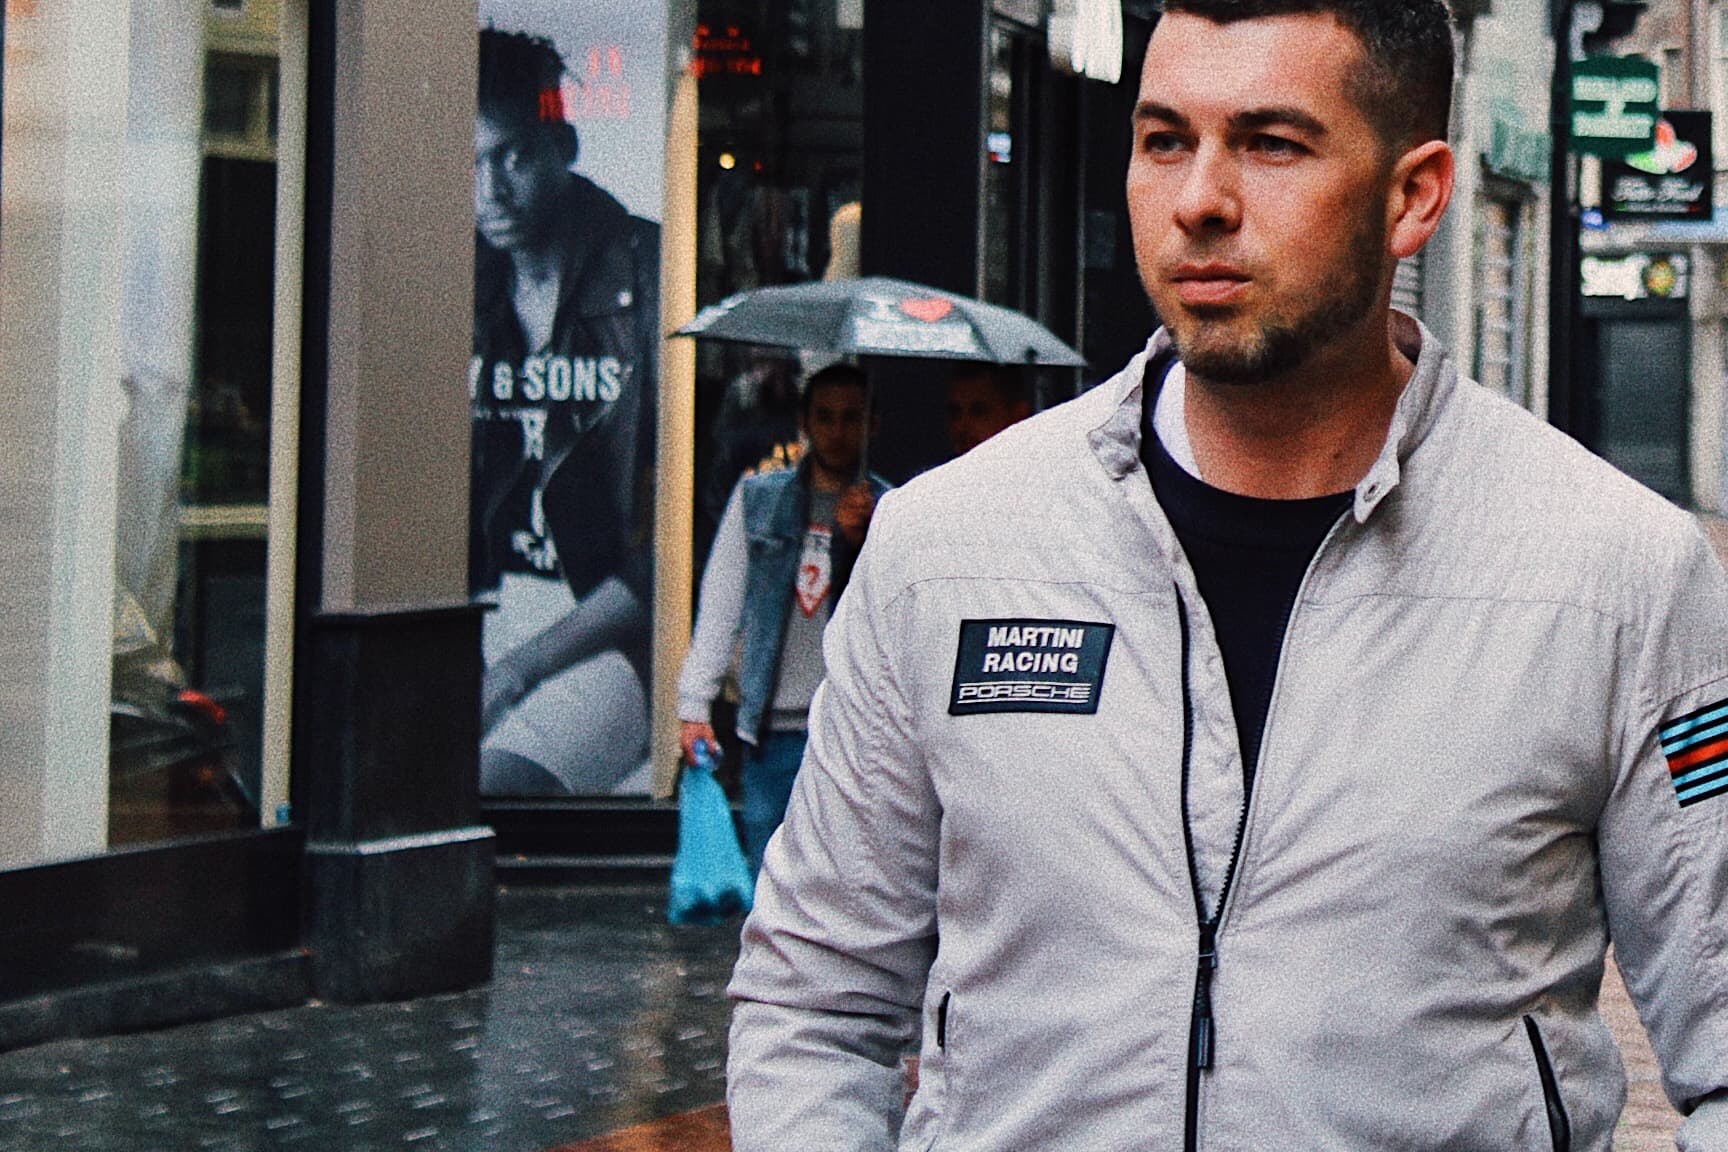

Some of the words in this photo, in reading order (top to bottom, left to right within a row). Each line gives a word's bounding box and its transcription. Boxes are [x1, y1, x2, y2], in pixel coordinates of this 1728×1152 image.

[522, 355, 622, 402] SONS
[987, 626, 1085, 648] MARTINI
[982, 651, 1079, 674] RACING
[958, 684, 1092, 700] PORSCHE
